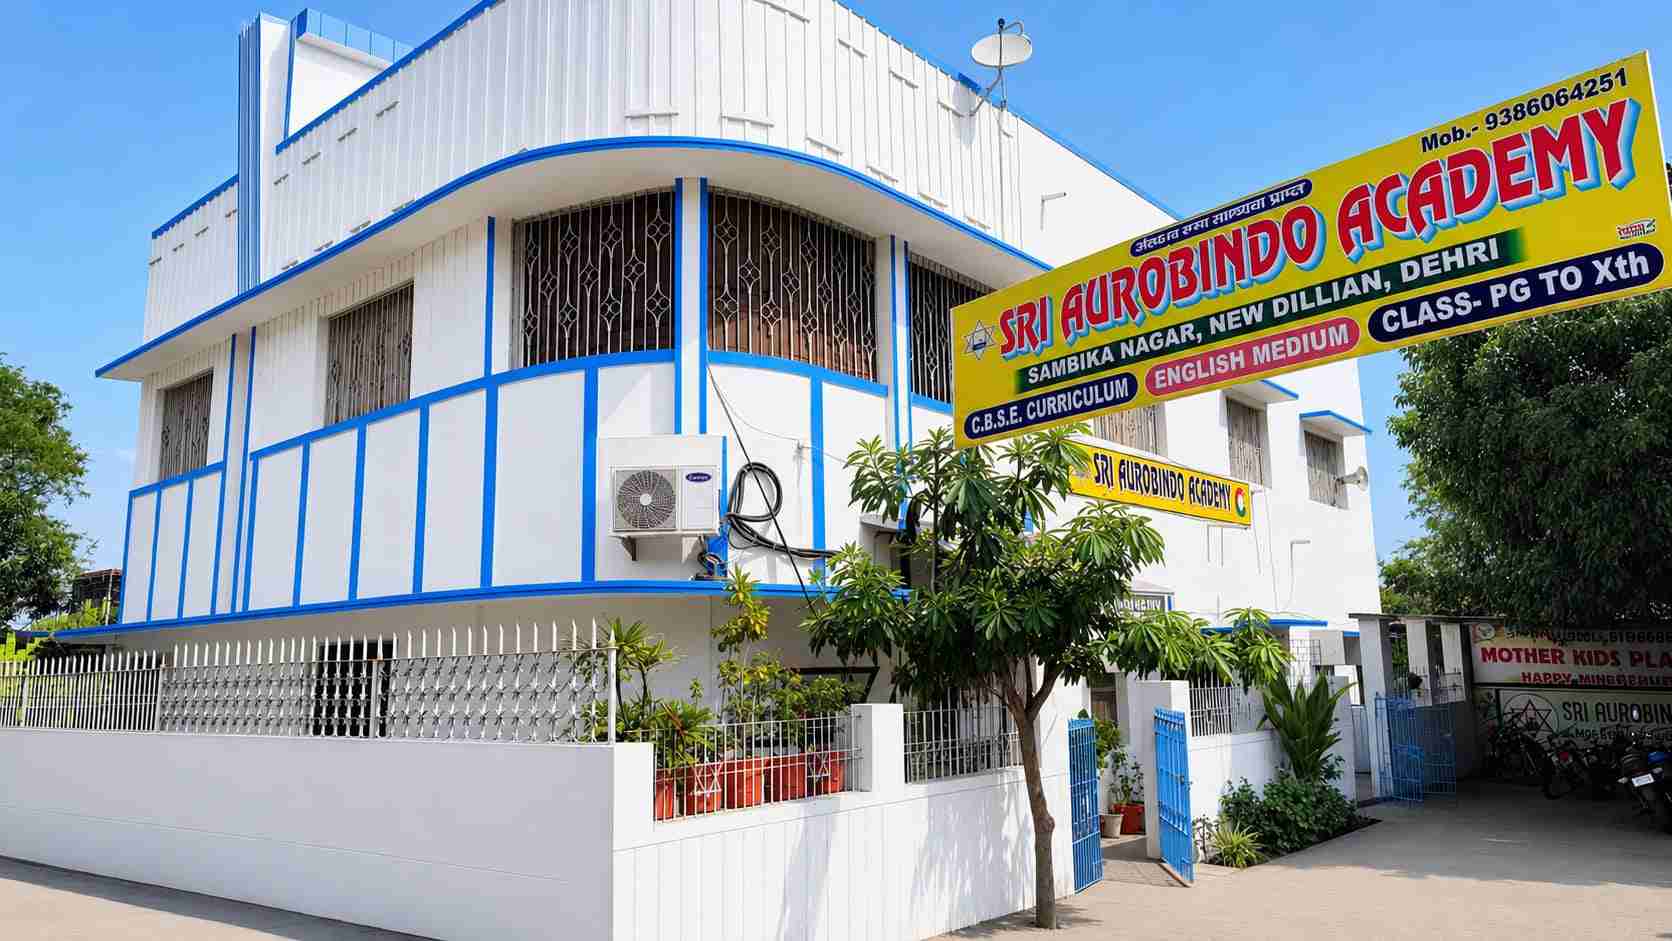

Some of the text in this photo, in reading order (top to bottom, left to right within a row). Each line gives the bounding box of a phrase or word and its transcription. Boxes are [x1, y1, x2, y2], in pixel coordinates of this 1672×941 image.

[1421, 67, 1628, 152] Mob.- 9386064251
[999, 296, 1053, 360] SRI
[1060, 204, 1325, 346] AUROBINDO
[1337, 98, 1641, 264] ACADEMY
[1028, 237, 1500, 385] SAMBIKA NAGAR, NEW DILLIAN, DEHRI
[1382, 251, 1649, 333] CLASS- PG TO Xth
[1154, 323, 1349, 390] ENGLISH MEDIUM
[971, 377, 1129, 434] C.B.S.E. CURRICULUM
[1093, 452, 1232, 511] SRI AUROBINDO ACADEMY
[1481, 648, 1565, 665] MOTHER
[1572, 649, 1621, 667] KIDS
[1562, 702, 1589, 722] SRI
